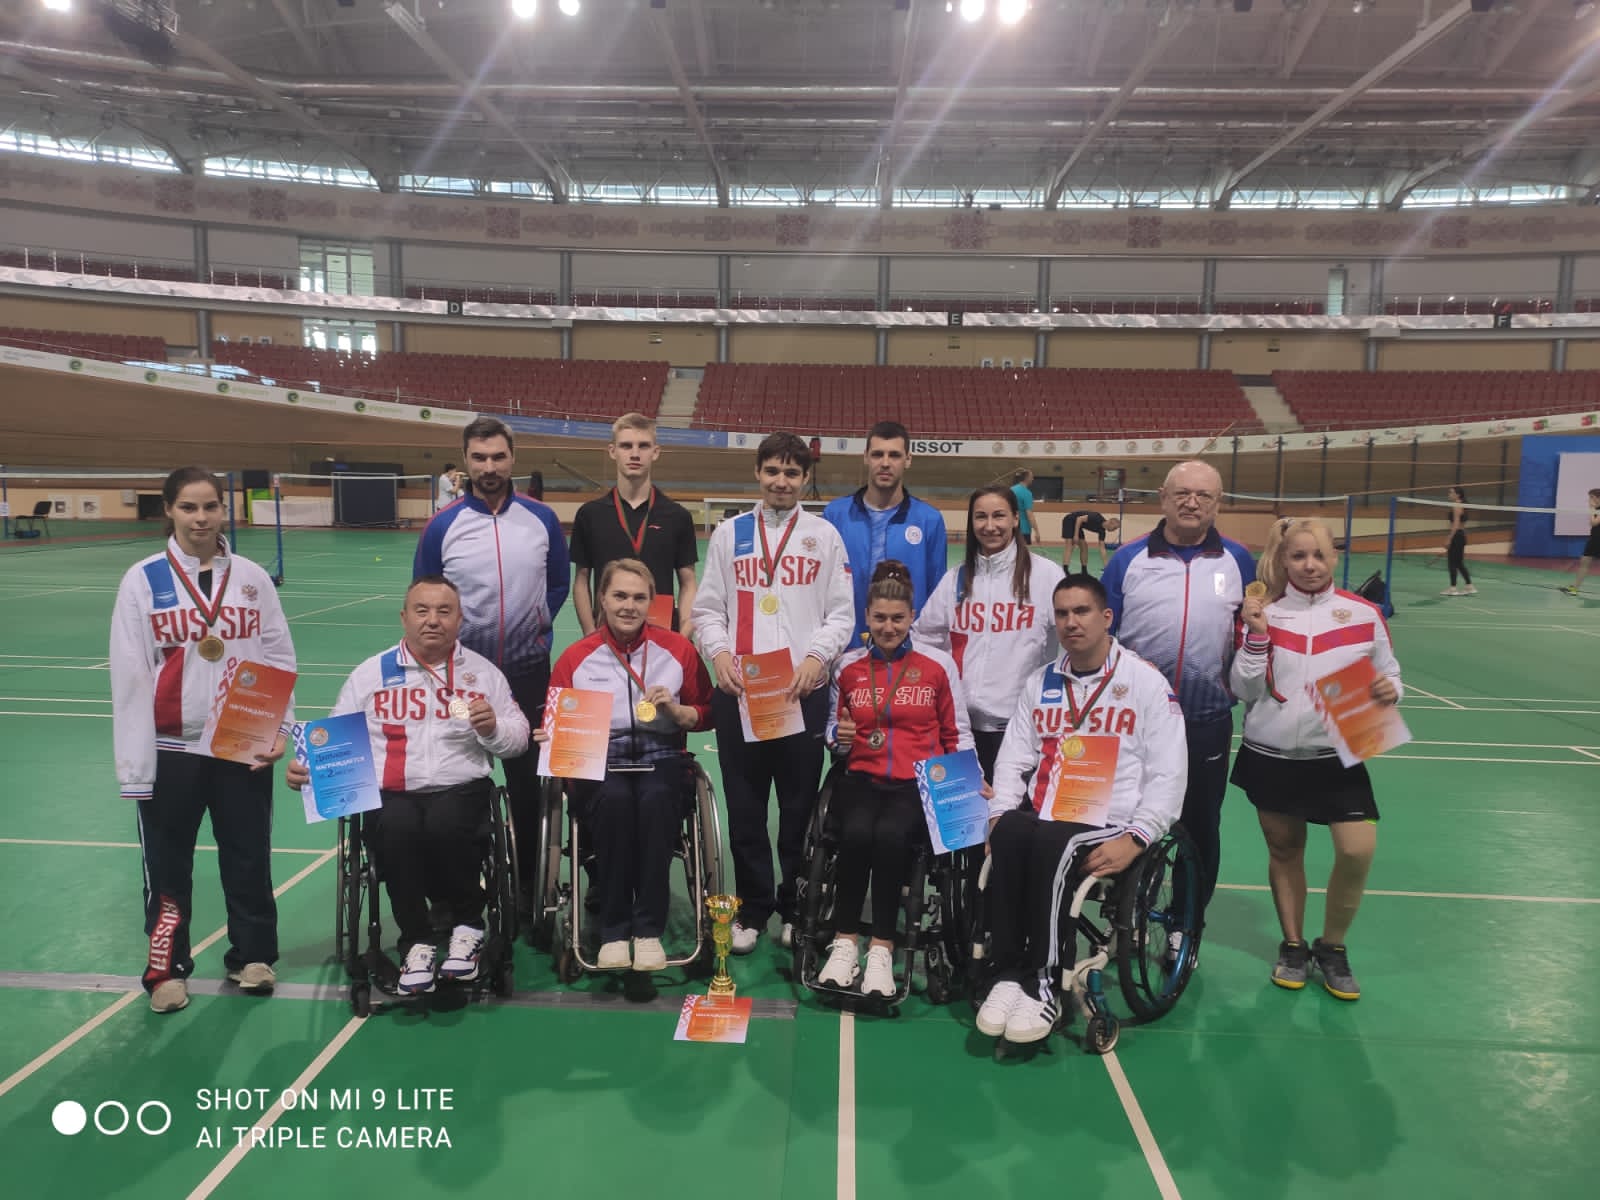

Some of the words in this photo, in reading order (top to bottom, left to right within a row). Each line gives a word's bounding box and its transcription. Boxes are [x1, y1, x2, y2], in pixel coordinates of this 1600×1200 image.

[450, 302, 460, 313] D
[951, 313, 961, 325] E
[1498, 315, 1508, 327] F
[911, 441, 964, 454] ISSOT
[734, 555, 821, 588] RUSSIA
[151, 606, 261, 643] RUSSIA
[374, 688, 486, 721] RUSS
[1032, 706, 1136, 735] RUSSIA
[150, 902, 179, 971] RUSSIA
